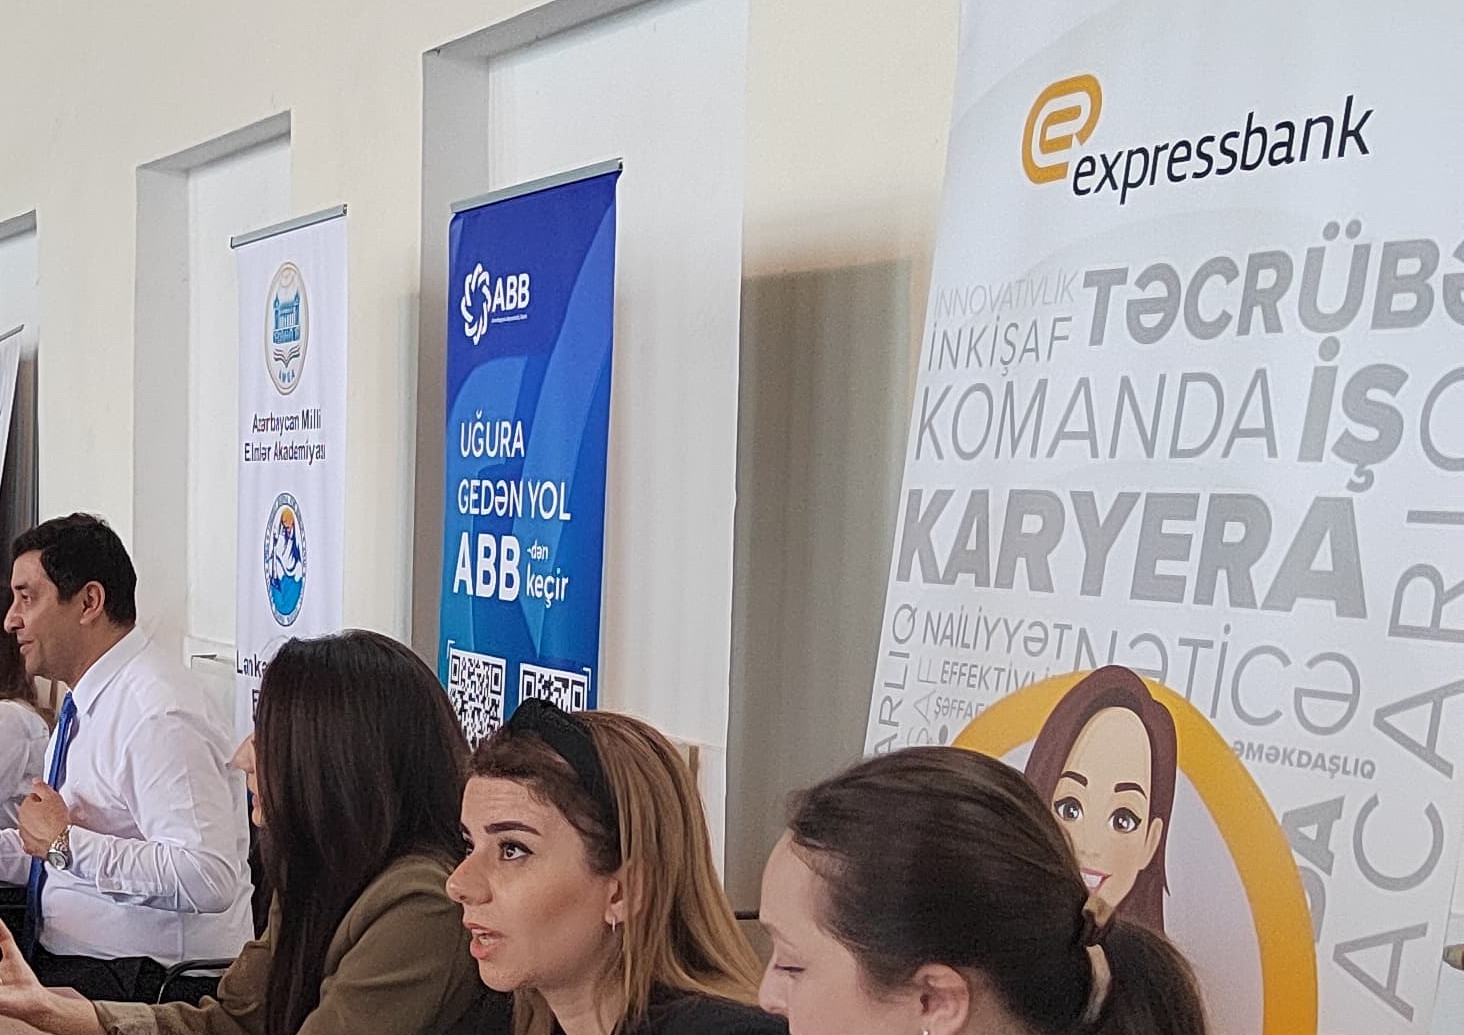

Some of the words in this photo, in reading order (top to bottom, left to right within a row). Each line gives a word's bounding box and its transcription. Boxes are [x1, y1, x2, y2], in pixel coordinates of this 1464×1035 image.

[1072, 95, 1374, 205] expressbank
[491, 273, 530, 312] ABB
[928, 315, 1073, 377] İNKİŞAF
[301, 408, 322, 430] Milli
[460, 409, 525, 458] UĞURA
[915, 367, 1278, 461] KOMANDA
[1297, 336, 1409, 493] İŞ
[457, 478, 524, 519] GEDƏN
[527, 480, 571, 521] YOL
[452, 531, 521, 602] ABB
[896, 488, 1368, 620] KARYERA
[526, 563, 569, 609] keçir
[922, 604, 1073, 661] NAİLİYYƏT
[874, 603, 918, 755] ARLIQ
[1232, 740, 1376, 779] ƏMƏKDAŞLIQ
